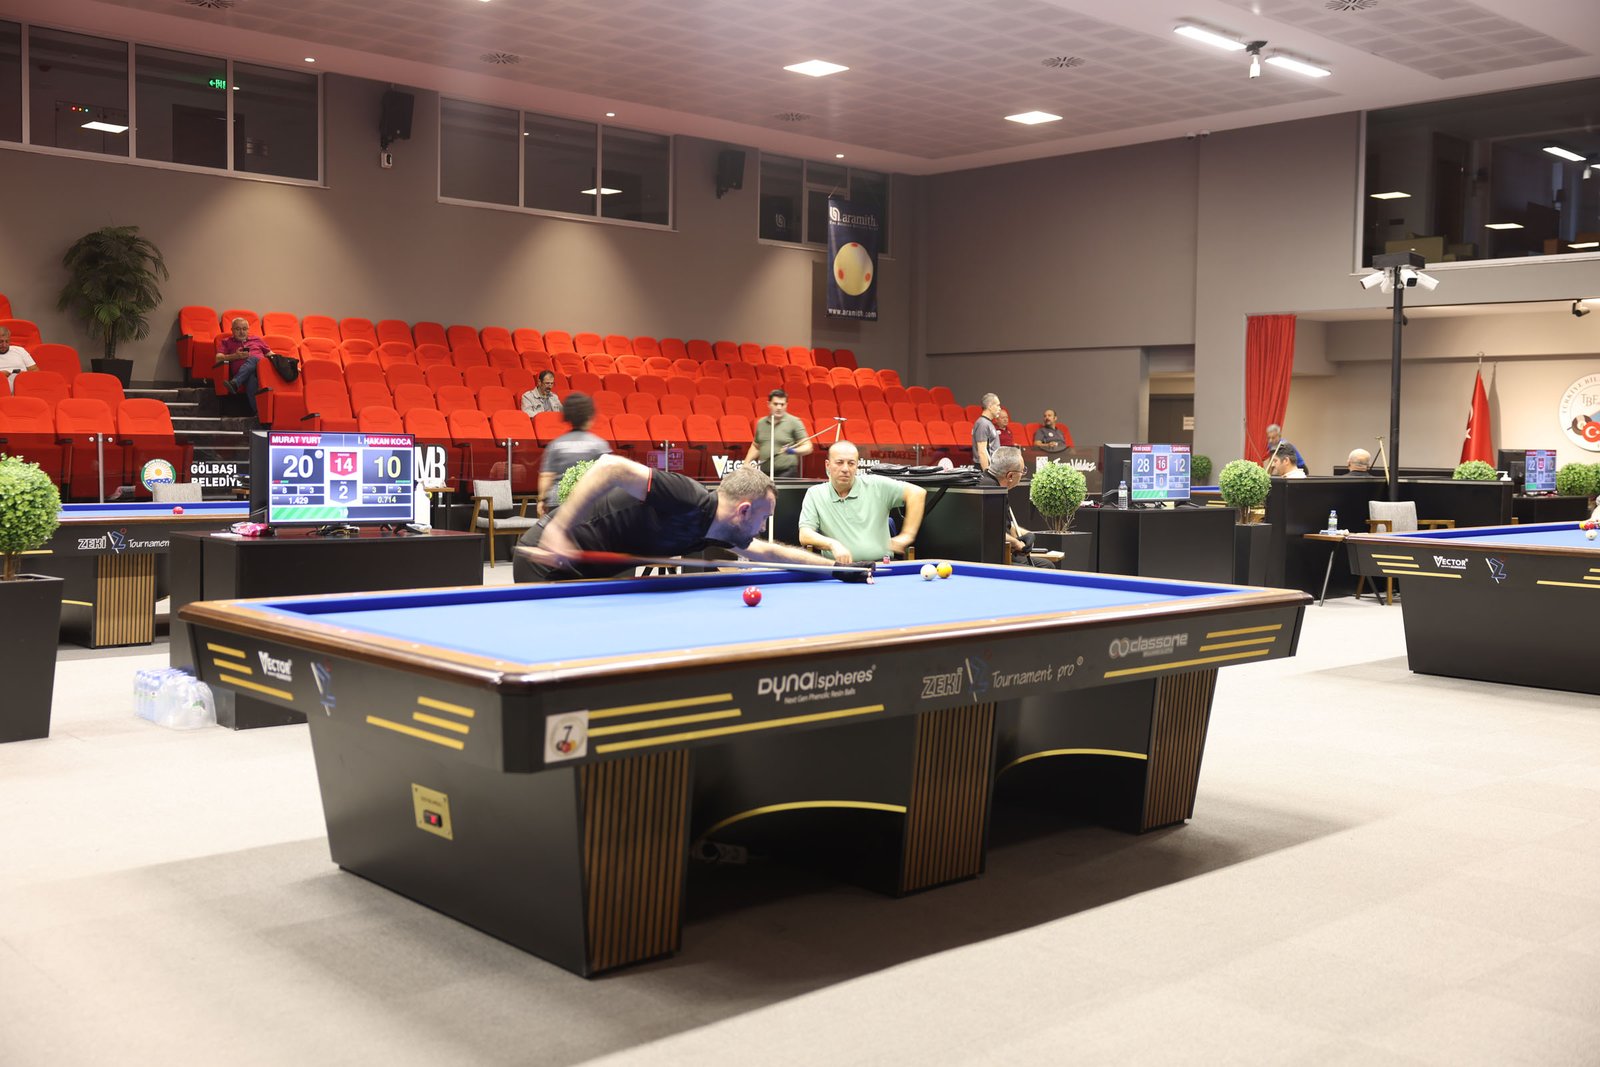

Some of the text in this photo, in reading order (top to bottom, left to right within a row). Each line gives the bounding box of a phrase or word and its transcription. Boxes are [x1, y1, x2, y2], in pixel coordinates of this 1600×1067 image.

[842, 213, 877, 226] aramith
[271, 436, 322, 444] MURAT YURT
[364, 437, 390, 445] HAKAN
[390, 438, 412, 446] KOCA
[190, 461, 237, 475] GÖLBAŞI
[283, 454, 314, 478] 20
[334, 457, 353, 472] 14
[374, 456, 401, 479] 10
[1137, 458, 1150, 473] 28
[1158, 459, 1166, 469] 16
[1174, 458, 1186, 472] 12
[338, 485, 348, 500] 2
[288, 497, 309, 505] 1.429
[377, 496, 397, 504] 0.714
[1433, 555, 1469, 568] VECTOR
[258, 651, 293, 675] VECTOR
[992, 664, 1053, 689] Tournament
[1057, 663, 1075, 681] pro
[563, 725, 574, 743] 7
